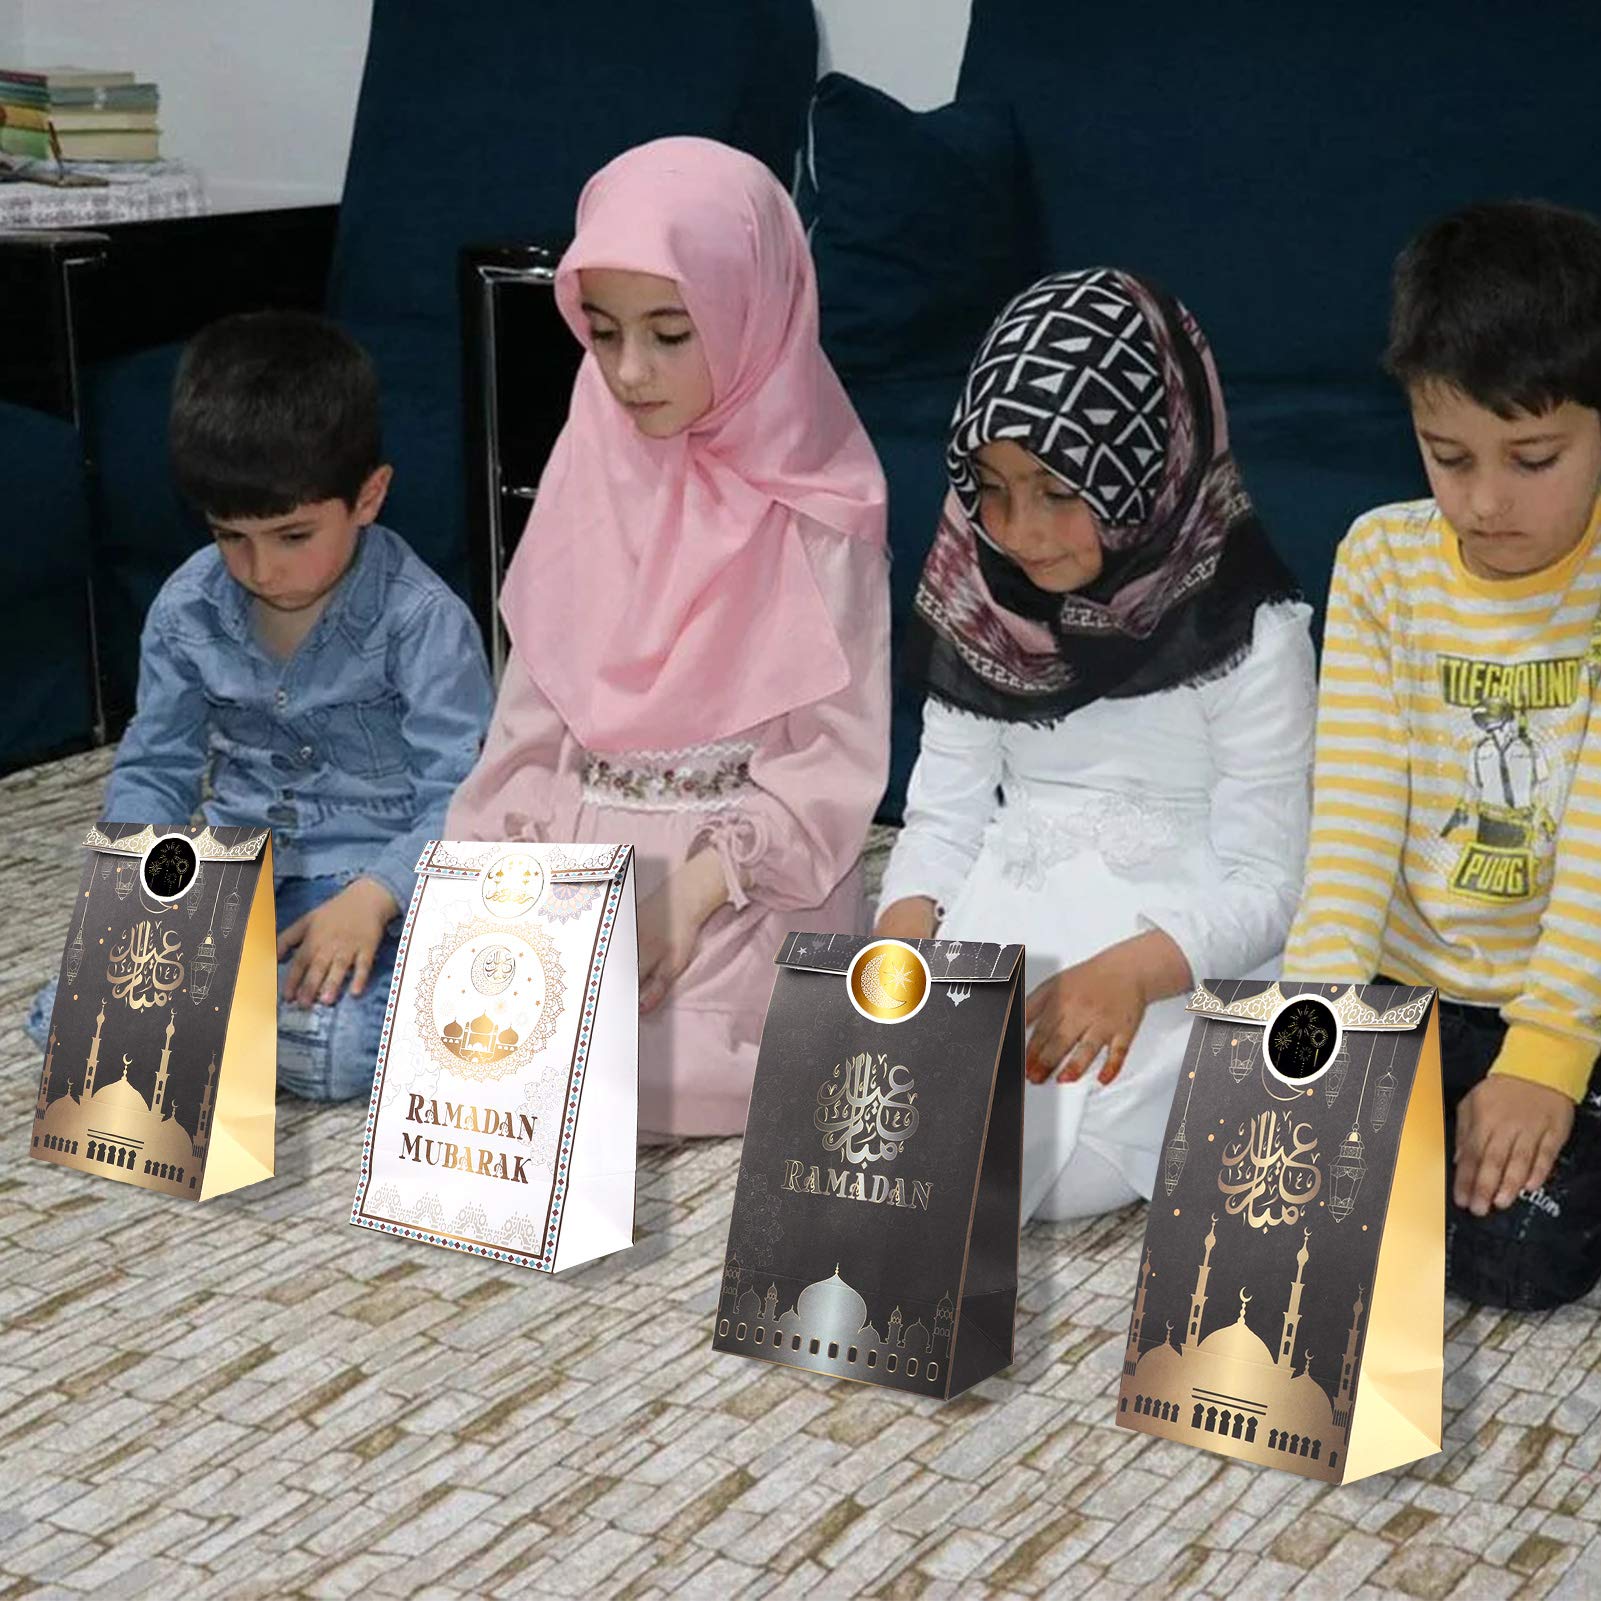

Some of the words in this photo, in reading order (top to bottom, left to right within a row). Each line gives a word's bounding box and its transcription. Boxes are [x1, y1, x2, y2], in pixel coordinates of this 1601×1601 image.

[1461, 853, 1524, 894] PUBG
[405, 1093, 538, 1142] RAMADAN
[399, 1132, 532, 1184] MUBARAK
[781, 1159, 934, 1211] RAMADAN
